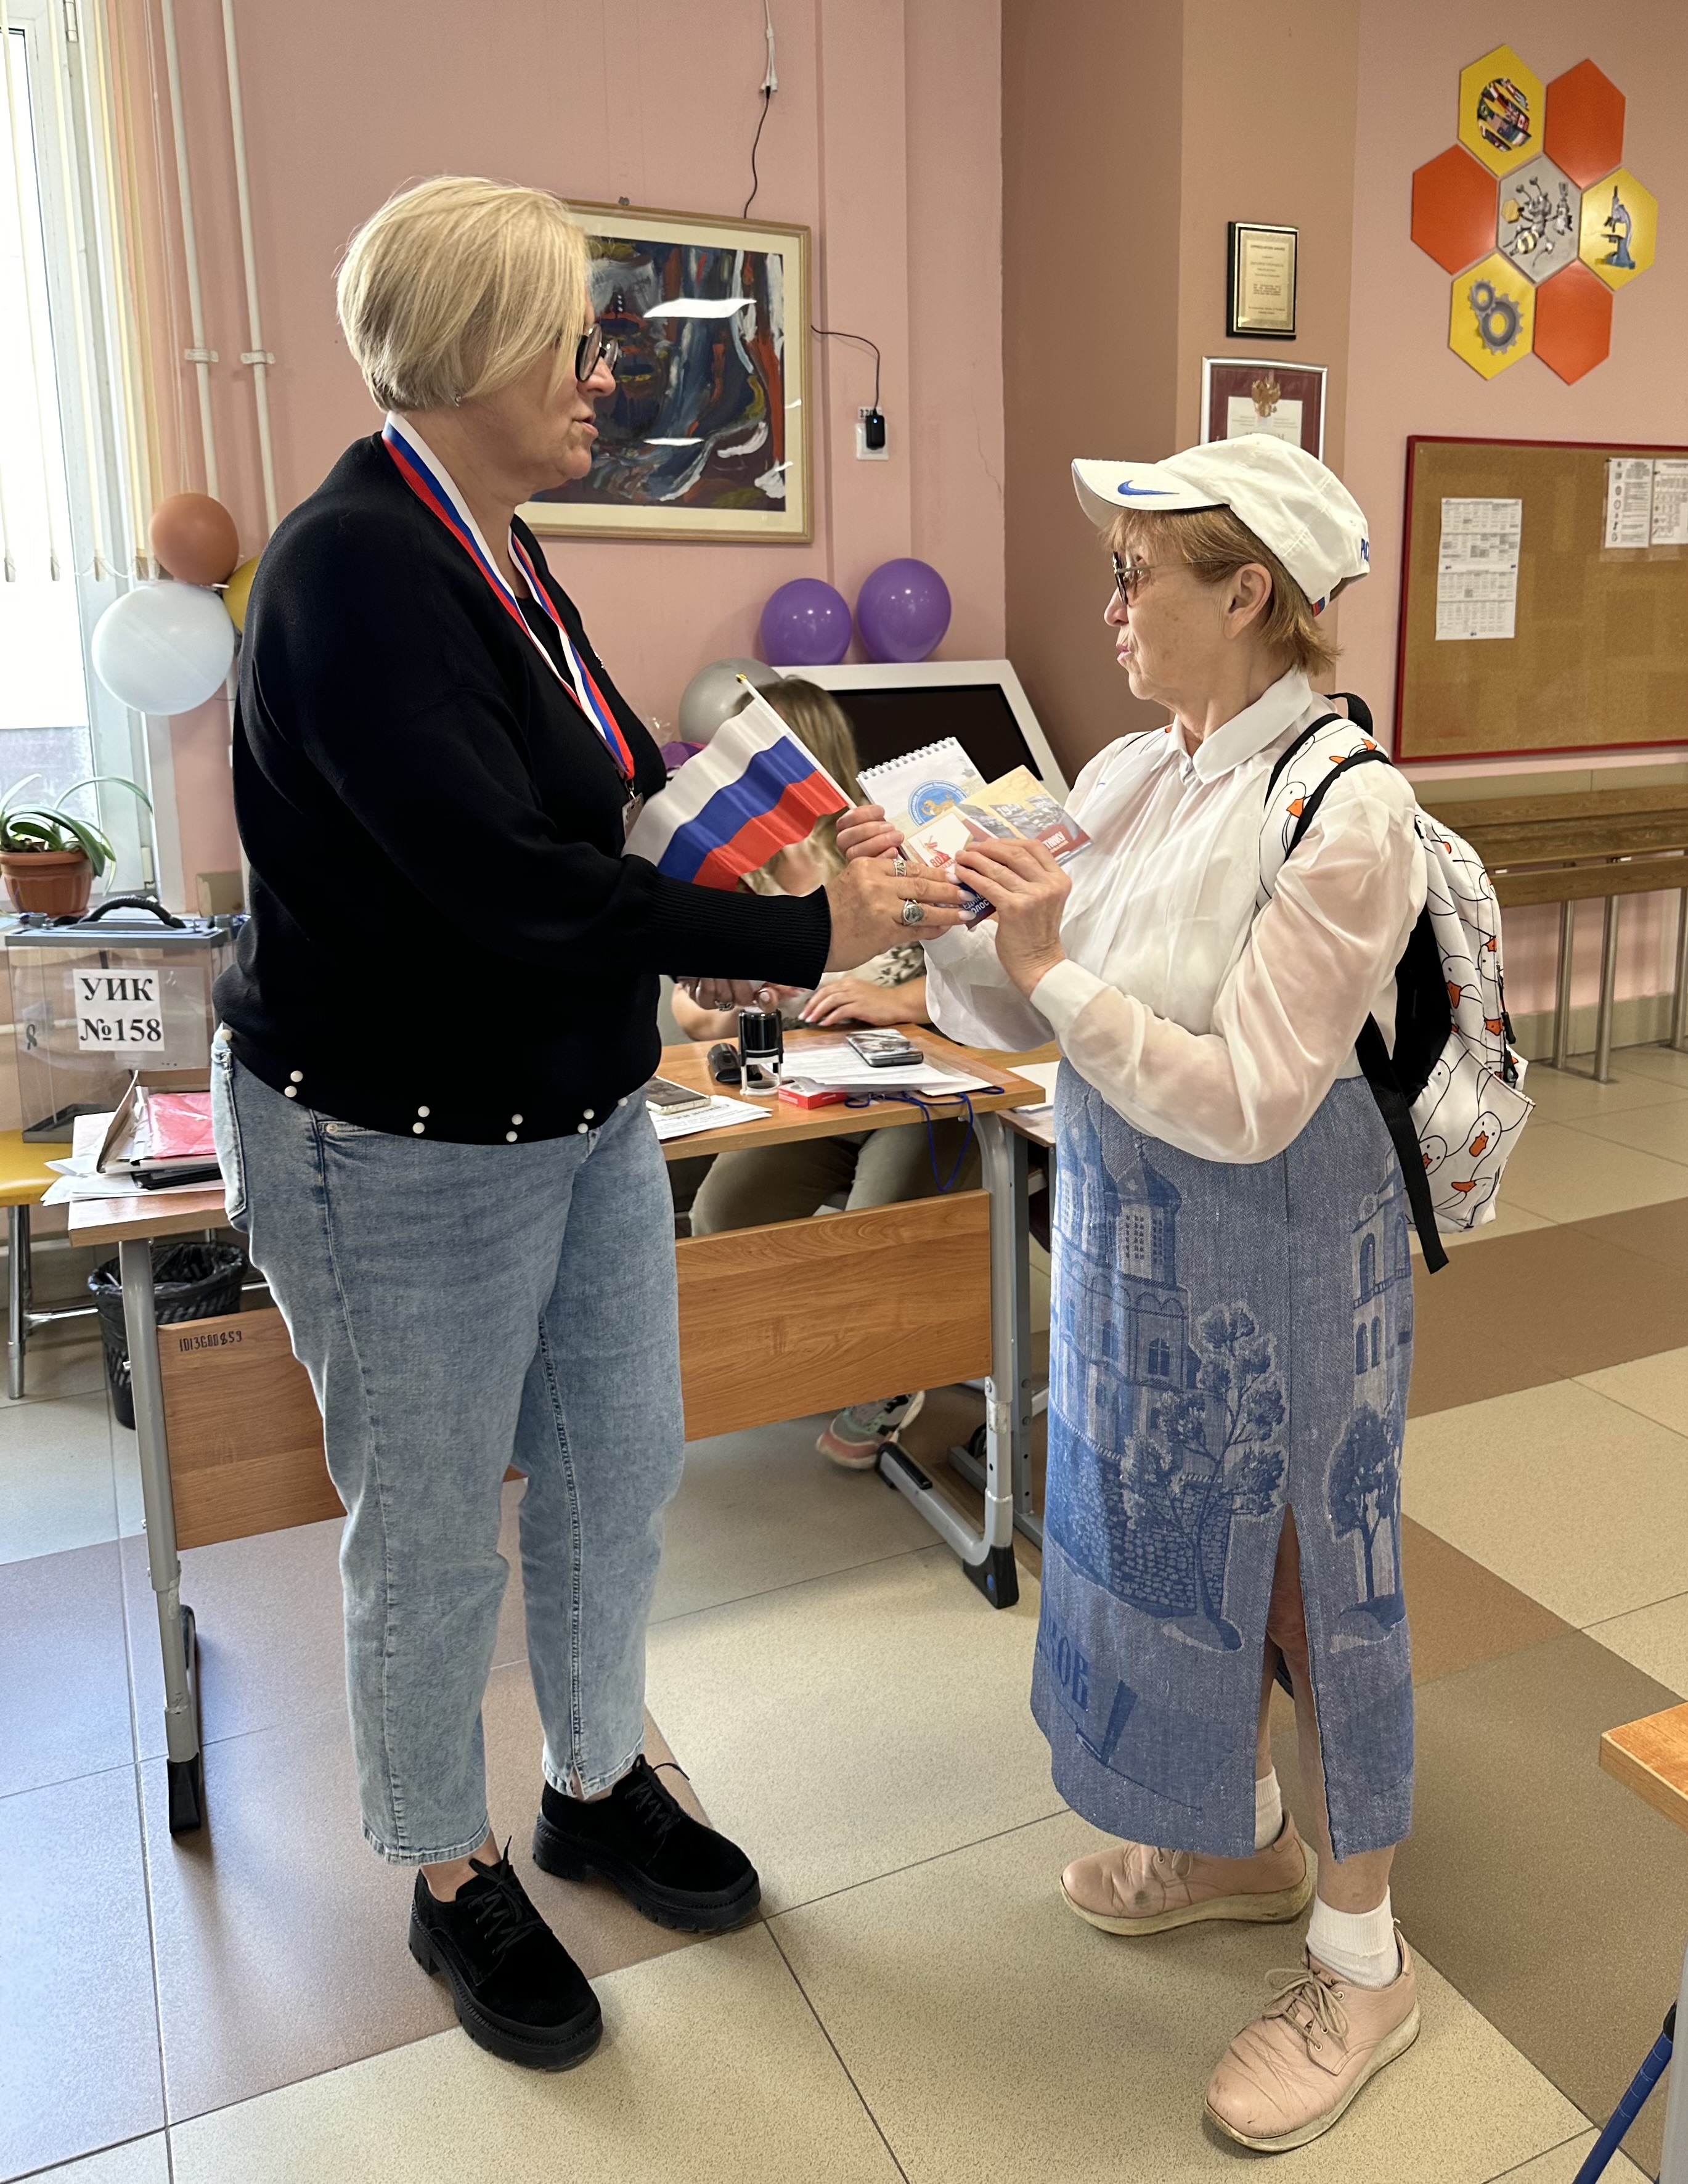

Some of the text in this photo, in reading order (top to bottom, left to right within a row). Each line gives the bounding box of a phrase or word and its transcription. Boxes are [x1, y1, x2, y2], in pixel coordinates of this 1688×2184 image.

[1042, 831, 1066, 849] ТНИКУ
[929, 855, 944, 868] 80
[80, 976, 154, 1002] УИК
[79, 1018, 163, 1042] №158
